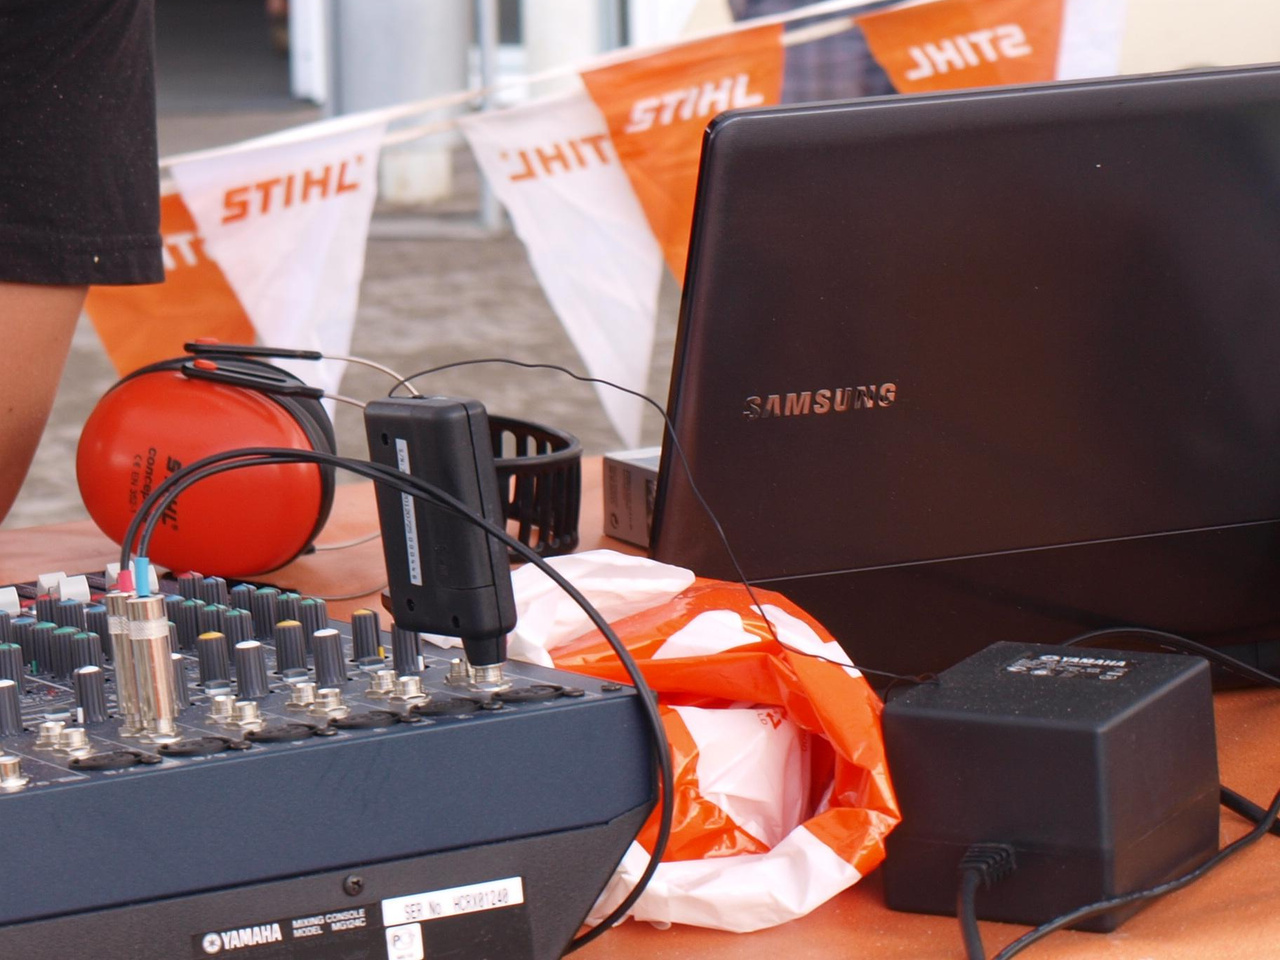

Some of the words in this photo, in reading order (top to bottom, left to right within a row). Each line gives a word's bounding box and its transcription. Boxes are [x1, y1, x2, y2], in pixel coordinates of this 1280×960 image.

[625, 73, 765, 134] STIHL
[221, 162, 361, 224] STIHL
[743, 382, 897, 421] SAMSUNG
[1061, 656, 1127, 667] YAMAHA
[292, 915, 325, 929] MIXING
[325, 908, 366, 923] CONSOLE
[404, 902, 423, 921] SER
[221, 923, 282, 950] YAMAHA
[293, 926, 324, 938] MODEL
